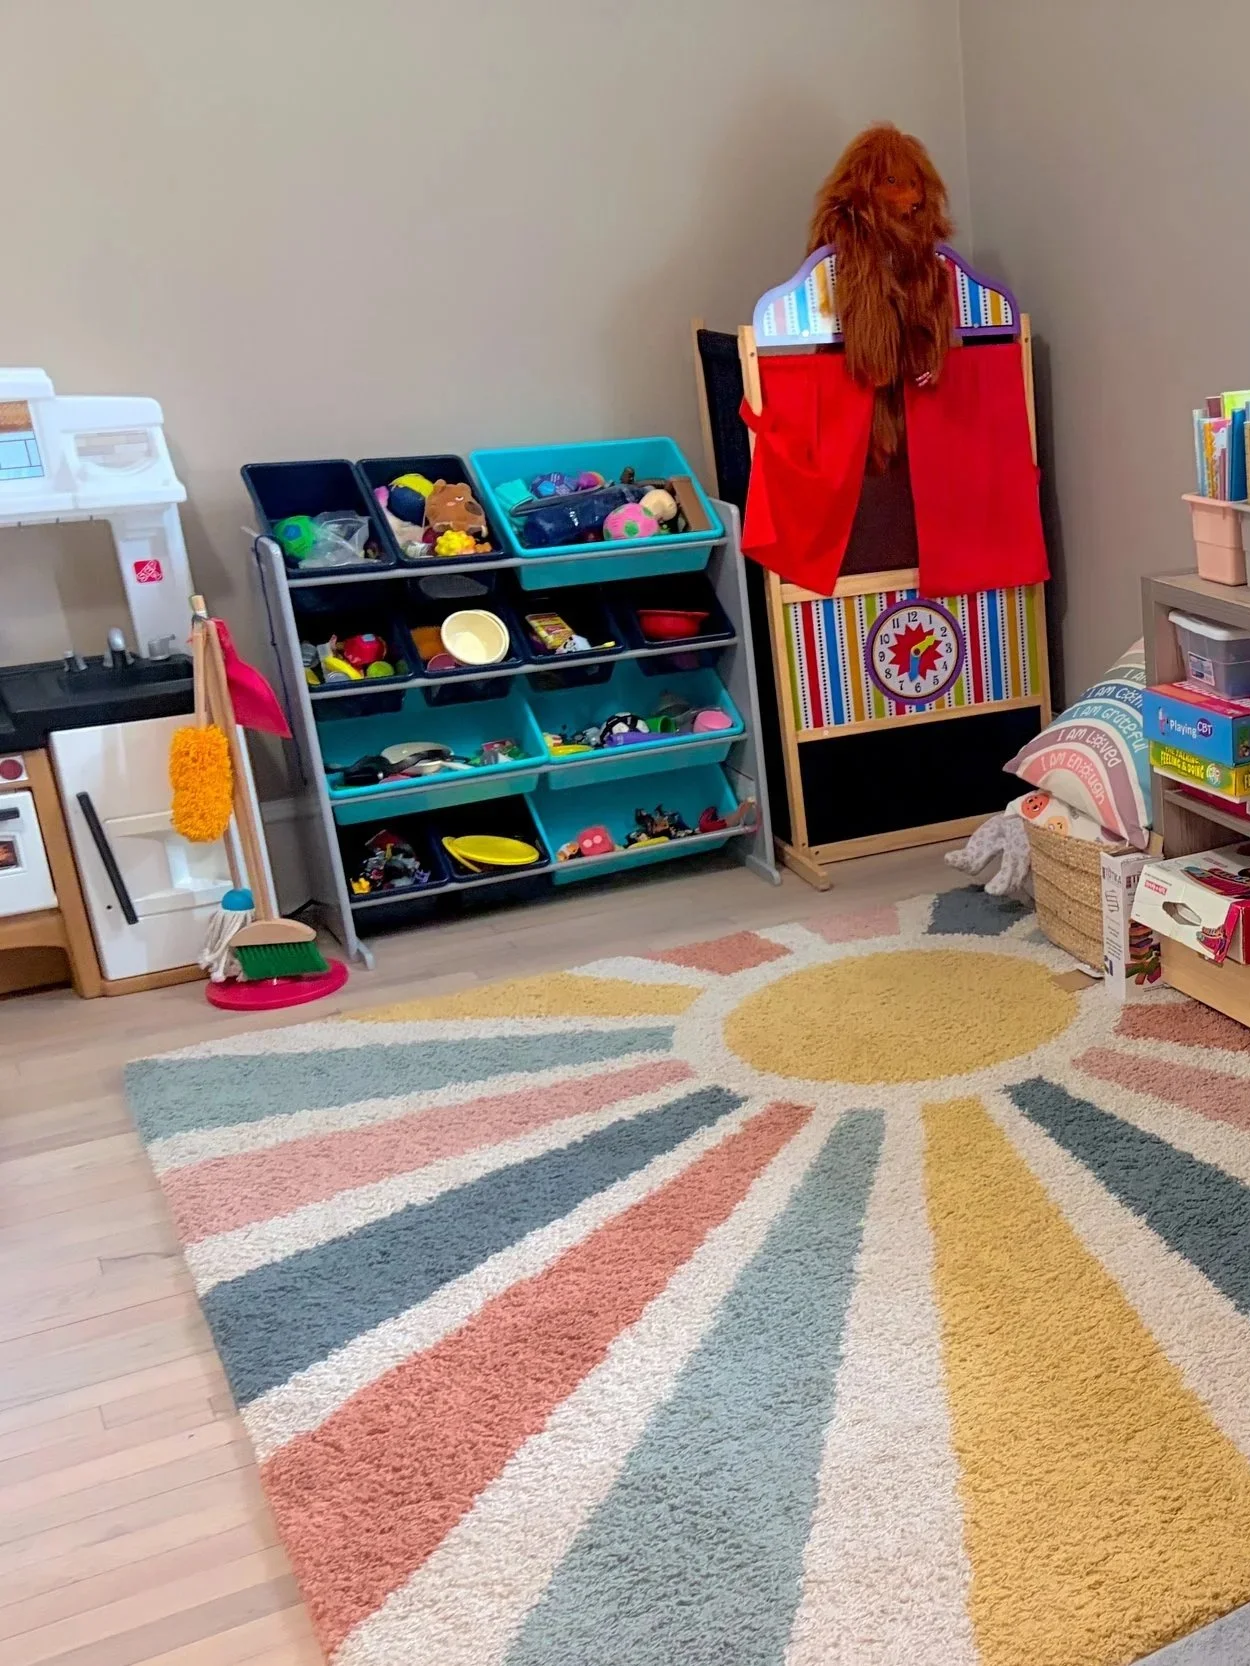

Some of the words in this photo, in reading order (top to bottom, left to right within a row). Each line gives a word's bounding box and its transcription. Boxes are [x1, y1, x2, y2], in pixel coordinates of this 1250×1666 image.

[907, 611, 918, 623] 12
[892, 618, 900, 629] 11
[940, 626, 947, 637] 2
[879, 634, 890, 645] 10
[945, 643, 952, 654] 3
[879, 652, 886, 662] 9
[942, 661, 948, 672] 4
[884, 668, 892, 679] 8
[898, 680, 904, 691] 7
[932, 675, 939, 686] 5
[915, 682, 922, 693] 6
[1095, 686, 1114, 697] AM
[1072, 708, 1080, 718] I
[1081, 705, 1102, 716] AM
[1170, 719, 1197, 739] Playing
[1197, 721, 1213, 735] CBT
[1057, 730, 1064, 742] I
[1066, 728, 1087, 741] AM
[1040, 756, 1047, 771] I
[1050, 751, 1067, 765] AM
[1160, 751, 1181, 769] FEELING
